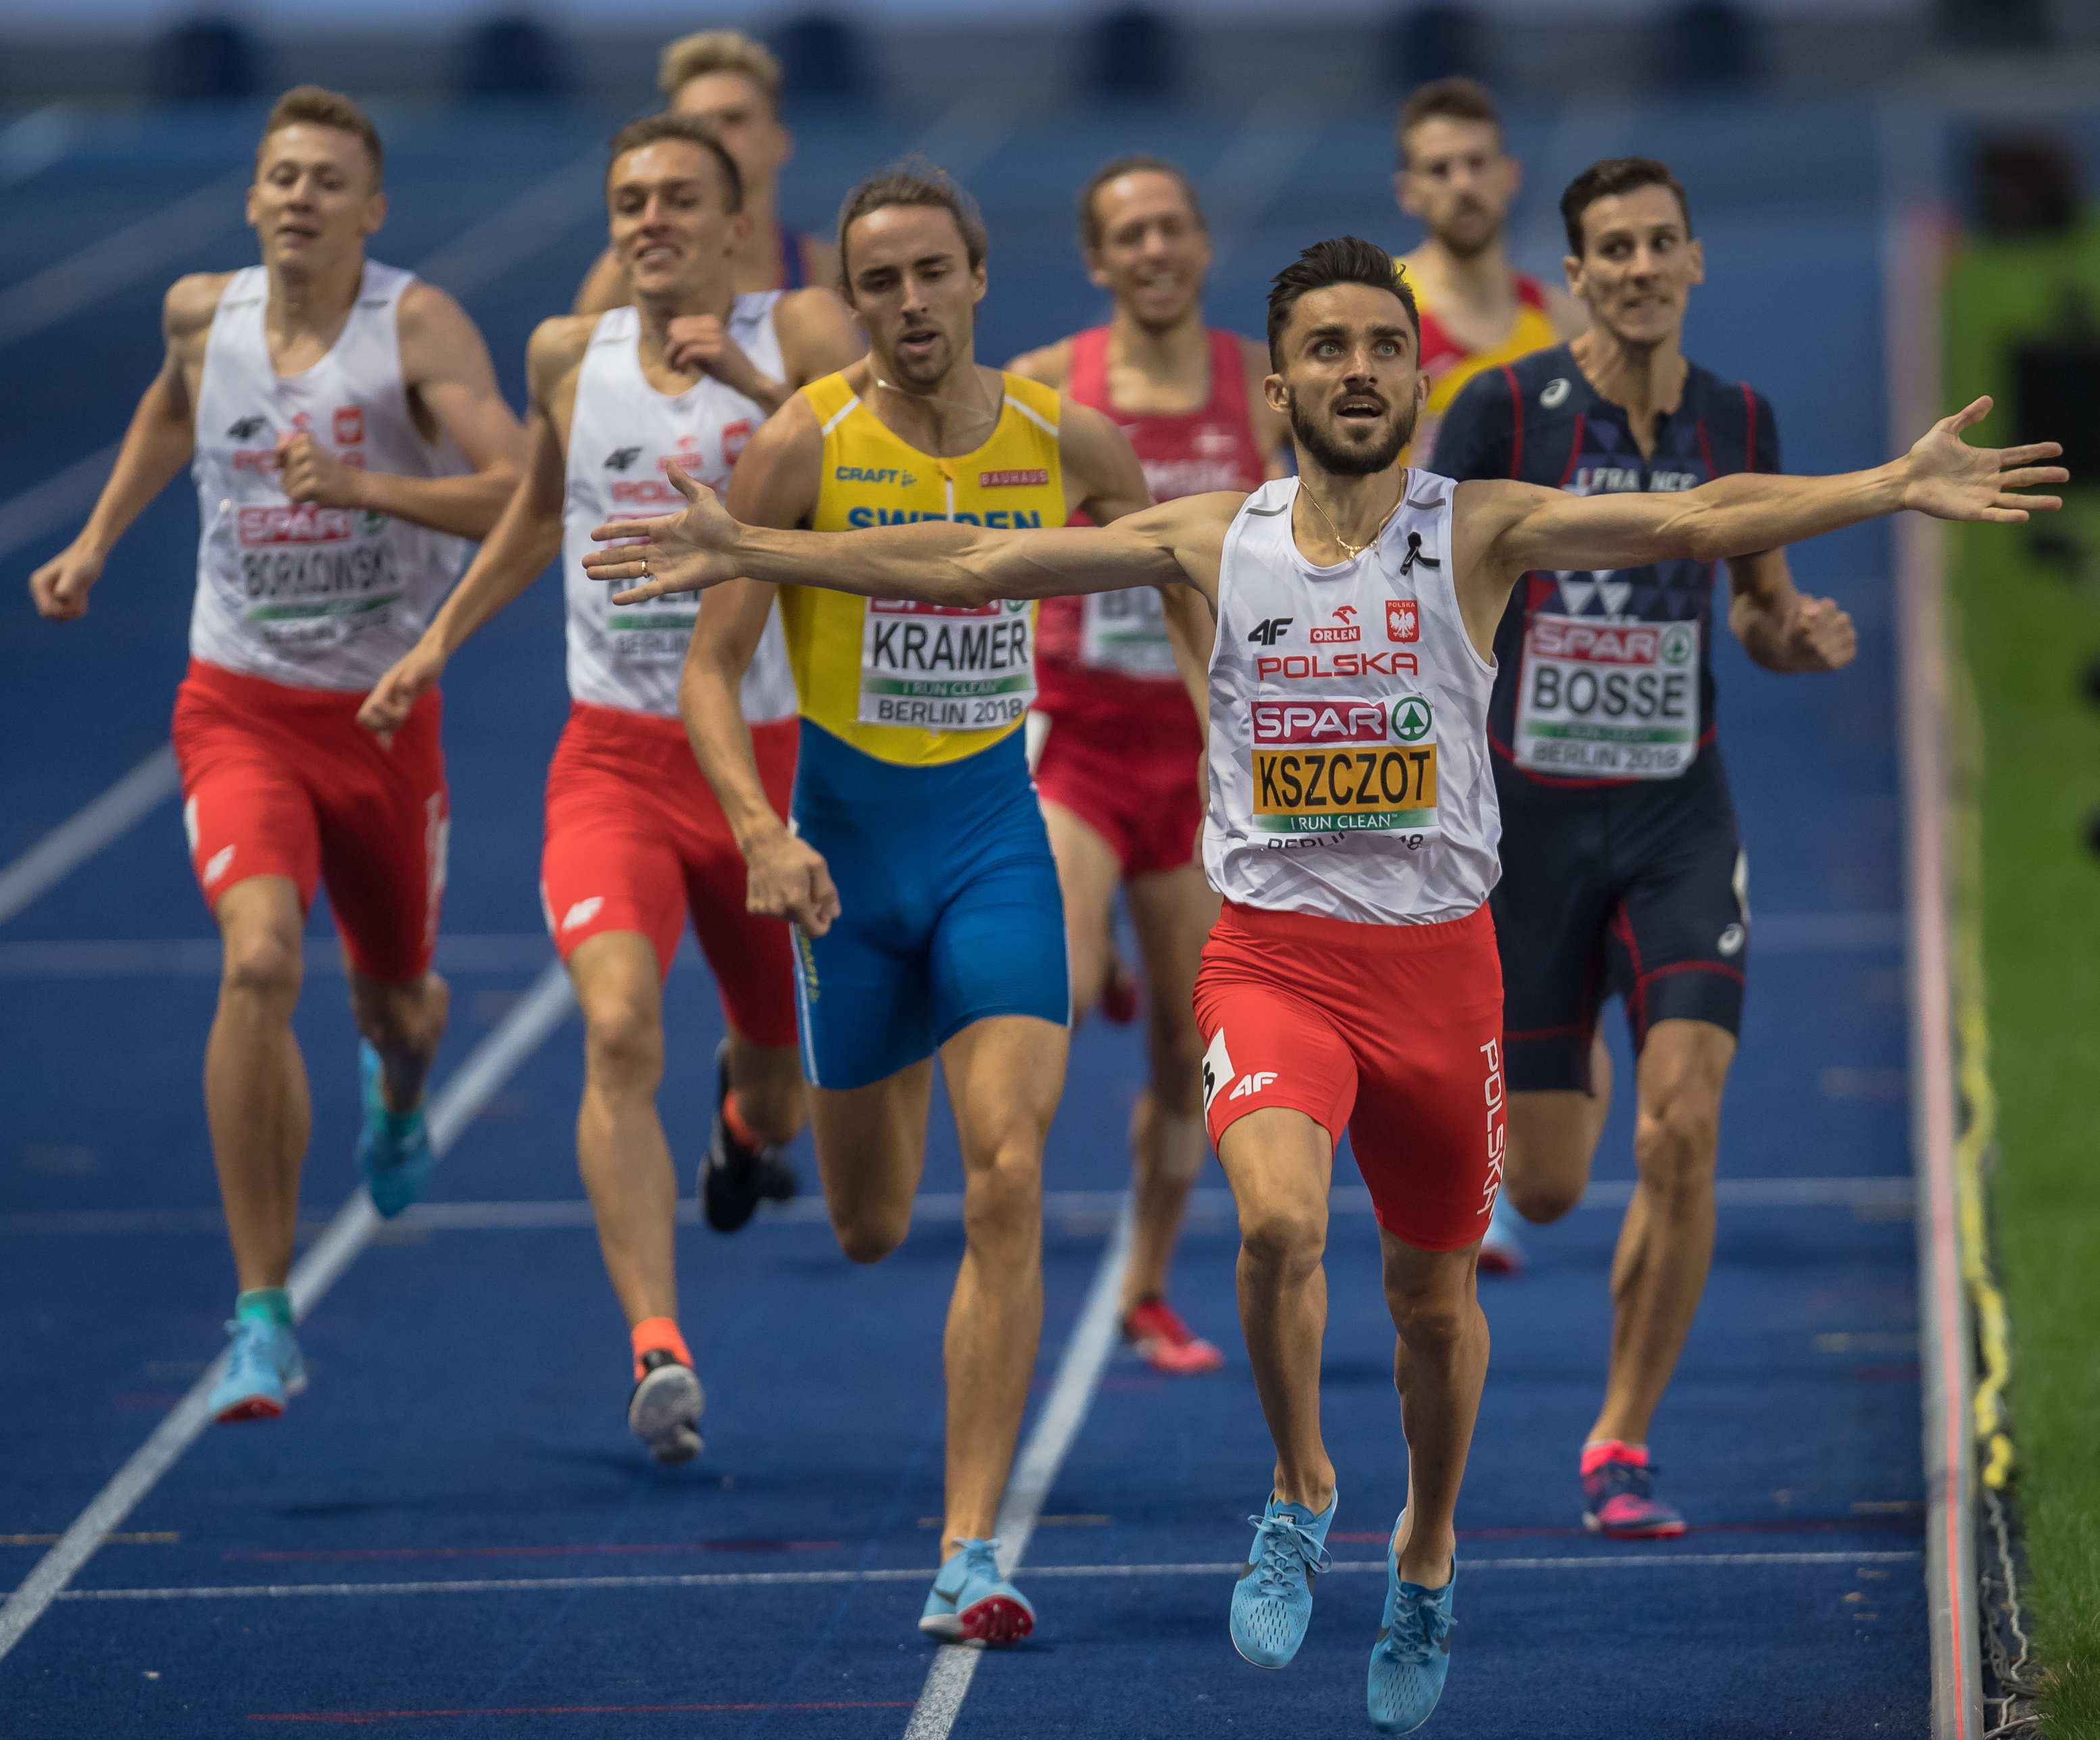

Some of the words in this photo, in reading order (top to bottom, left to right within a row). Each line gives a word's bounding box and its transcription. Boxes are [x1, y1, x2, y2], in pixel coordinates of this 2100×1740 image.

[835, 465, 899, 484] CRAFT
[981, 469, 1048, 487] BAUHAUS
[873, 618, 1028, 670] KRAMER
[1313, 628, 1358, 641] ORLEN
[1534, 622, 1656, 662] SPAR
[1257, 652, 1418, 681] POLSKA
[913, 682, 947, 695] RUN
[1533, 665, 1685, 718] BOSSE
[879, 699, 966, 723] BERLIN
[973, 697, 1023, 723] 2018
[1255, 707, 1383, 738] SPAR
[1259, 750, 1430, 808] KSZCZOT
[1290, 817, 1296, 830] I
[1300, 816, 1332, 830] RUN
[1476, 1037, 1505, 1220] POLSKA
